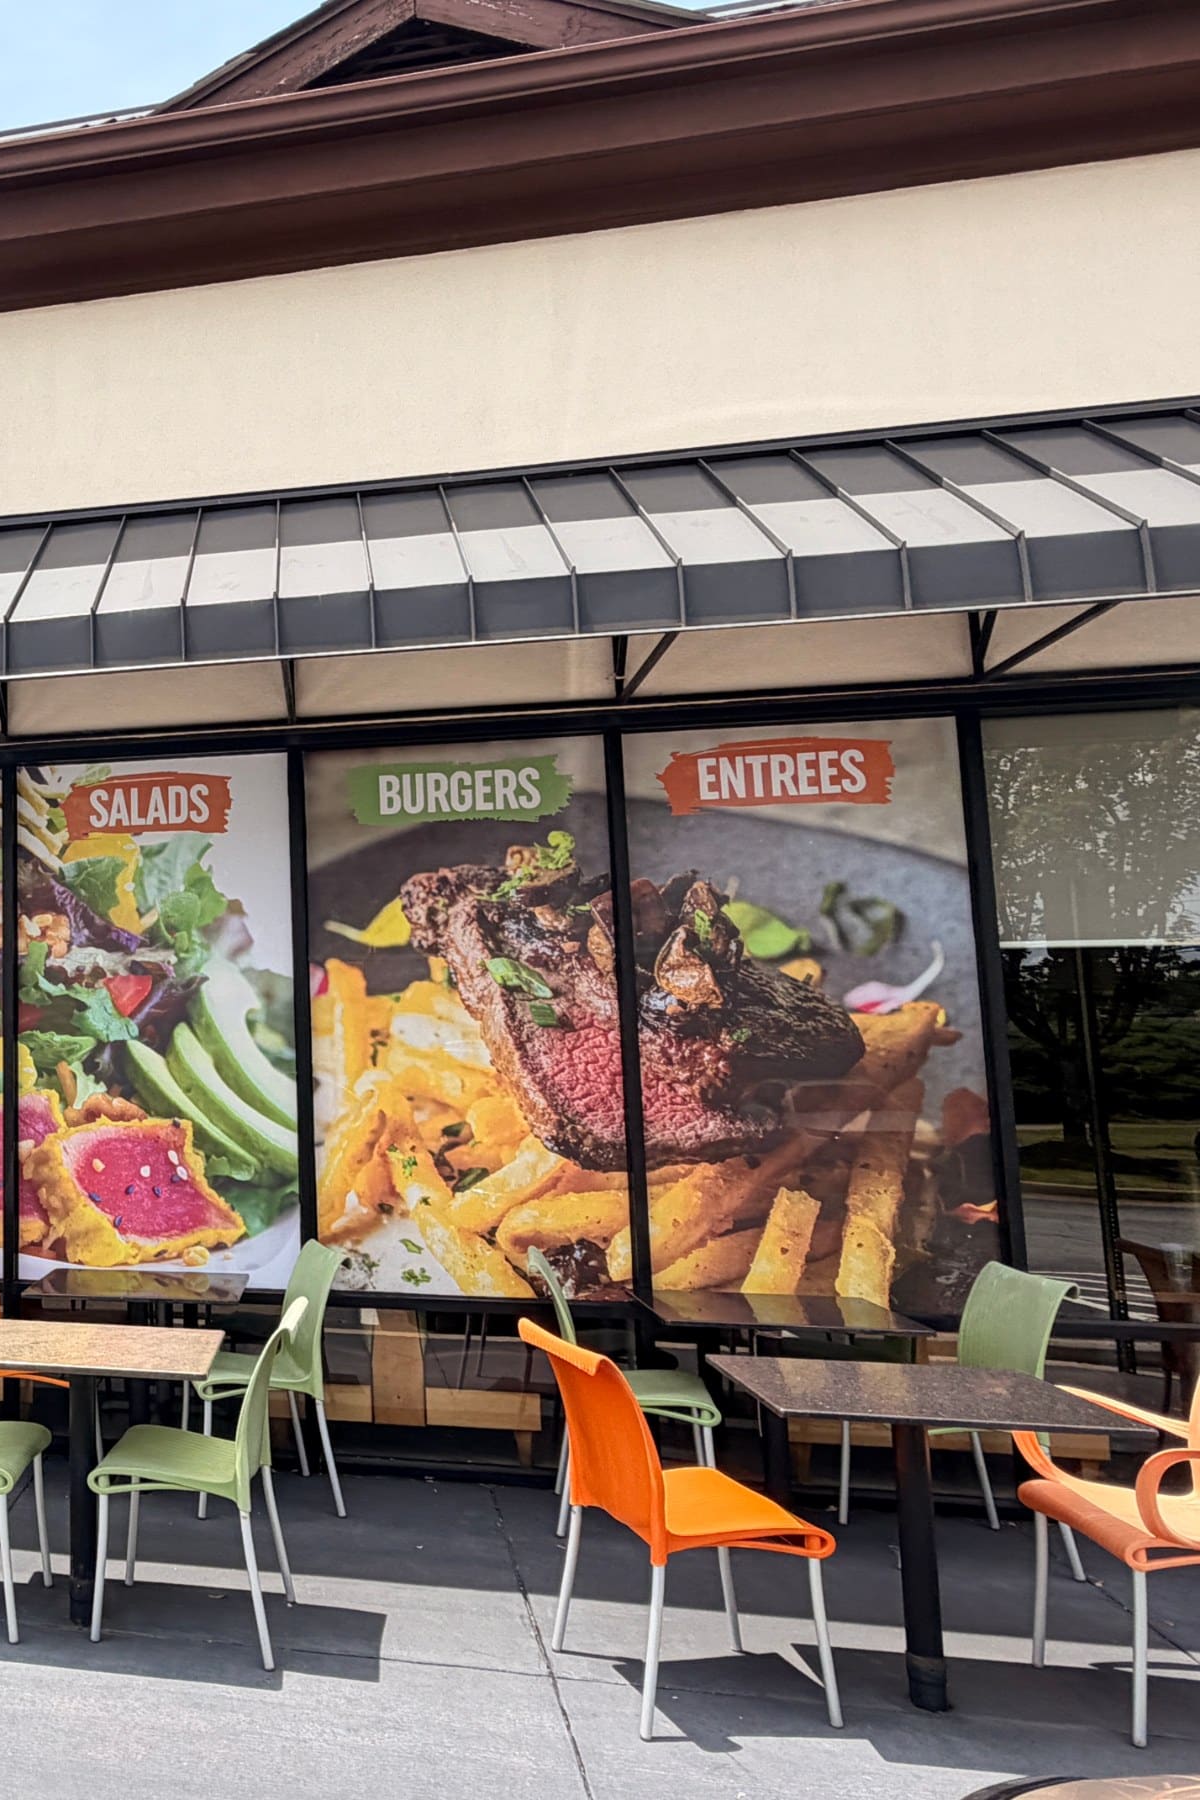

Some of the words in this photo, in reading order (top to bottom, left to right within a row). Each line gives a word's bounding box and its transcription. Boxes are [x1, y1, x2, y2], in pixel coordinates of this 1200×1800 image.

[378, 767, 542, 816] BURGERS
[697, 749, 867, 801] ENTREES
[89, 784, 210, 828] SALADS
